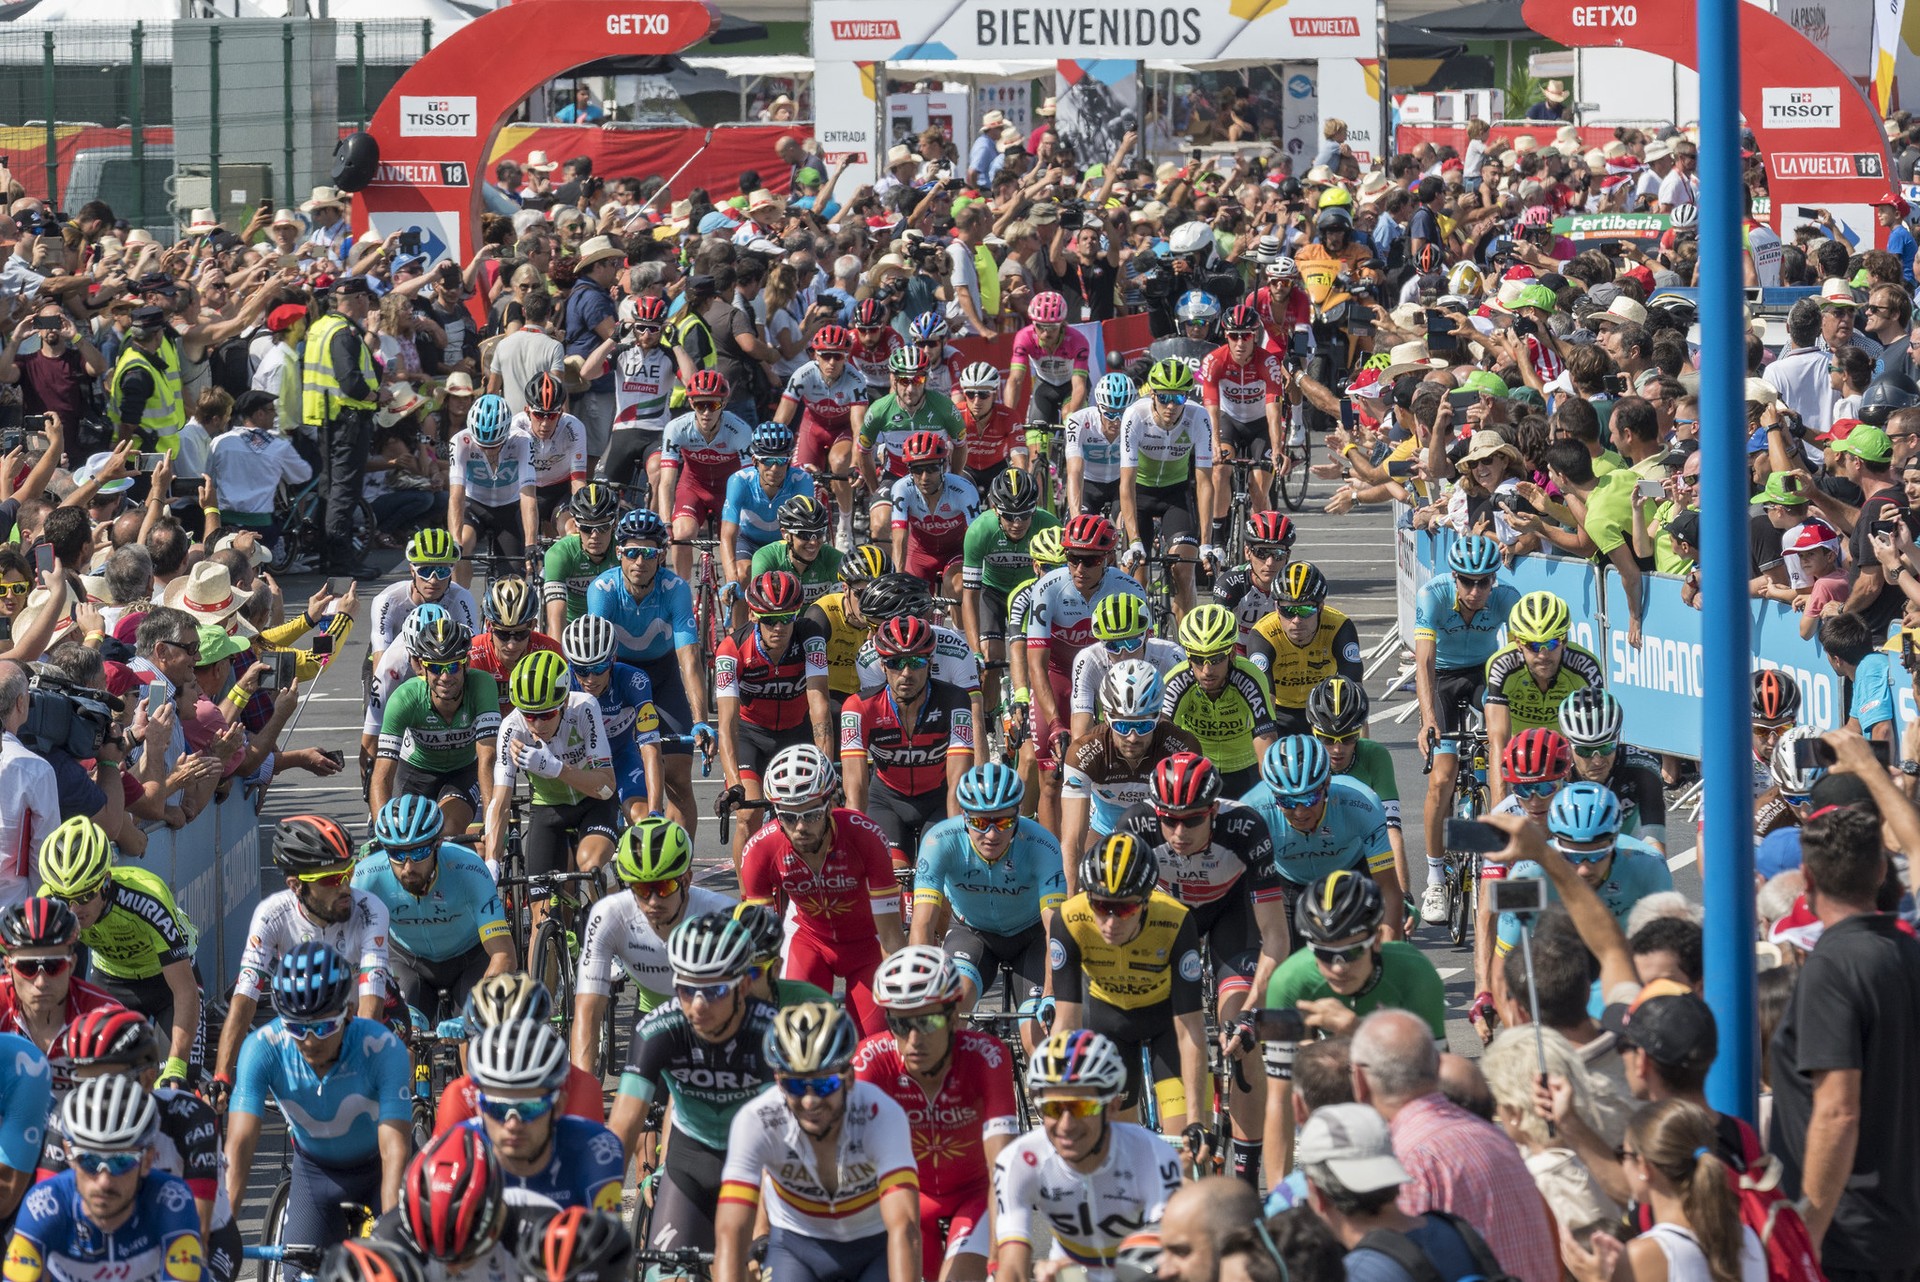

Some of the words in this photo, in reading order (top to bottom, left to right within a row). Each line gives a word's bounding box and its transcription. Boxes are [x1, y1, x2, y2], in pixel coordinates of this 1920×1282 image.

[1572, 6, 1637, 26] GETXO
[606, 14, 669, 35] GETXO
[836, 24, 850, 38] LA
[850, 22, 896, 37] VUELTA
[976, 8, 1203, 47] BIENVENIDOS
[1295, 20, 1310, 34] LA
[1311, 19, 1355, 34] VUELTA
[1769, 105, 1834, 117] TISSOT
[406, 113, 471, 126] TISSOT
[824, 131, 867, 143] ENTRADA
[1347, 130, 1371, 142] RADA
[1781, 158, 1798, 174] LA
[1799, 158, 1851, 174] VUELTA
[1860, 156, 1877, 174] 18
[385, 165, 437, 182] VUELTA
[446, 165, 462, 183] 18
[1571, 215, 1663, 231] Fertiberia
[624, 364, 661, 379] UAE
[623, 382, 658, 394] Emirates
[1225, 386, 1261, 396] LOTTO
[808, 403, 851, 414] Alpecin
[1088, 448, 1120, 461] sk
[1142, 443, 1192, 453] dimension
[689, 451, 730, 463] Alpecin
[1173, 535, 1199, 544] Deloitte
[1039, 576, 1062, 597] ARETI
[1115, 575, 1143, 591] ARETI
[1226, 574, 1245, 587] UAE
[804, 581, 830, 597] URAL
[1213, 585, 1228, 598] FAB
[809, 641, 826, 652] TA
[937, 633, 970, 651] BORA
[1489, 650, 1524, 688] MURIA
[1073, 659, 1085, 699] cervélo
[957, 713, 972, 724] TA
[1183, 714, 1243, 731] EUSKADI
[444, 728, 477, 743] RURA
[585, 707, 598, 749] cervélo
[954, 726, 974, 742] HEU
[501, 727, 513, 767] cervélo
[869, 742, 948, 764] BMC
[1118, 791, 1147, 799] AG2R
[586, 825, 619, 841] Deloitte
[1128, 816, 1157, 836] UAE
[1227, 817, 1256, 837] UAE
[1036, 837, 1060, 856] astana
[1248, 839, 1273, 861] FAB
[1283, 846, 1350, 860] STANA
[355, 869, 366, 879] air
[366, 864, 392, 875] astana
[1175, 869, 1209, 880] UAE
[787, 873, 864, 894] Cofidis
[954, 882, 1031, 896] ASTANA
[116, 887, 180, 943] MURIAS
[583, 914, 603, 968] cervélo
[628, 941, 656, 953] Deloitte
[670, 1067, 763, 1090] BORA
[907, 1103, 977, 1126] ofidis
[184, 1122, 215, 1146] FAB
